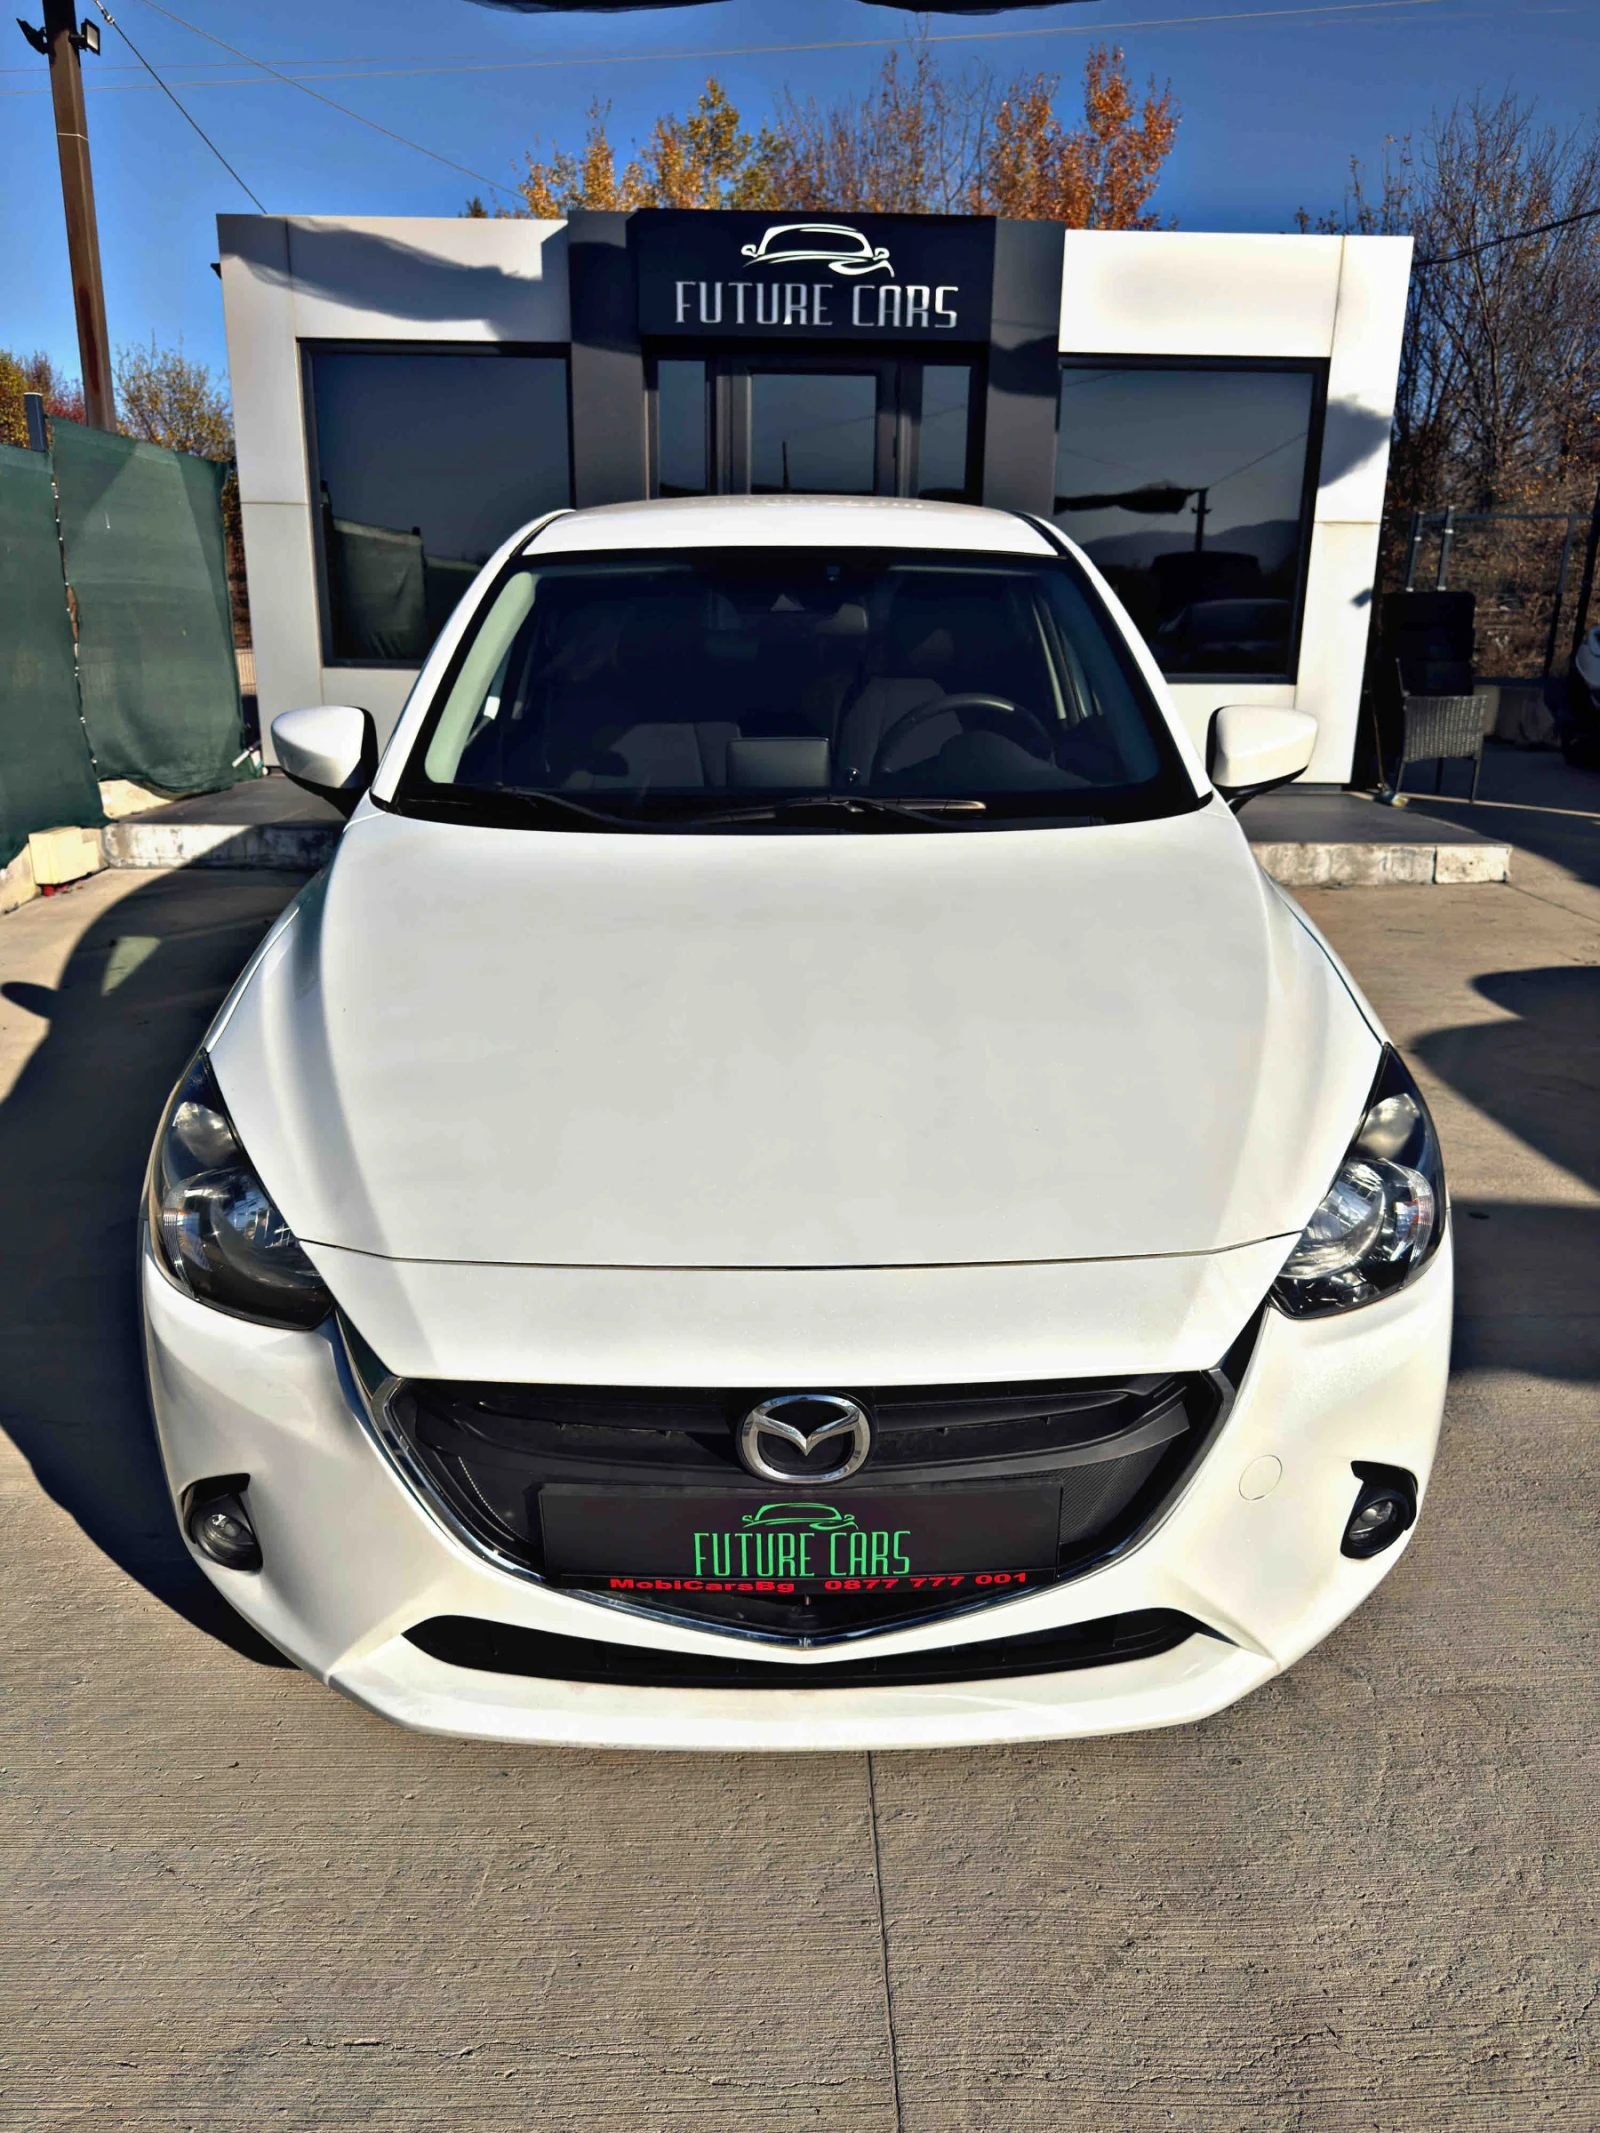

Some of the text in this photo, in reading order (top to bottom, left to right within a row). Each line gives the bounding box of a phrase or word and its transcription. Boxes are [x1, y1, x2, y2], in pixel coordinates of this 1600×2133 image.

[675, 281, 959, 328] FUTURE CARS
[693, 1530, 911, 1577] FUTURE CARS
[609, 1572, 1028, 1593] MobiCarsBg 0877 777 001
